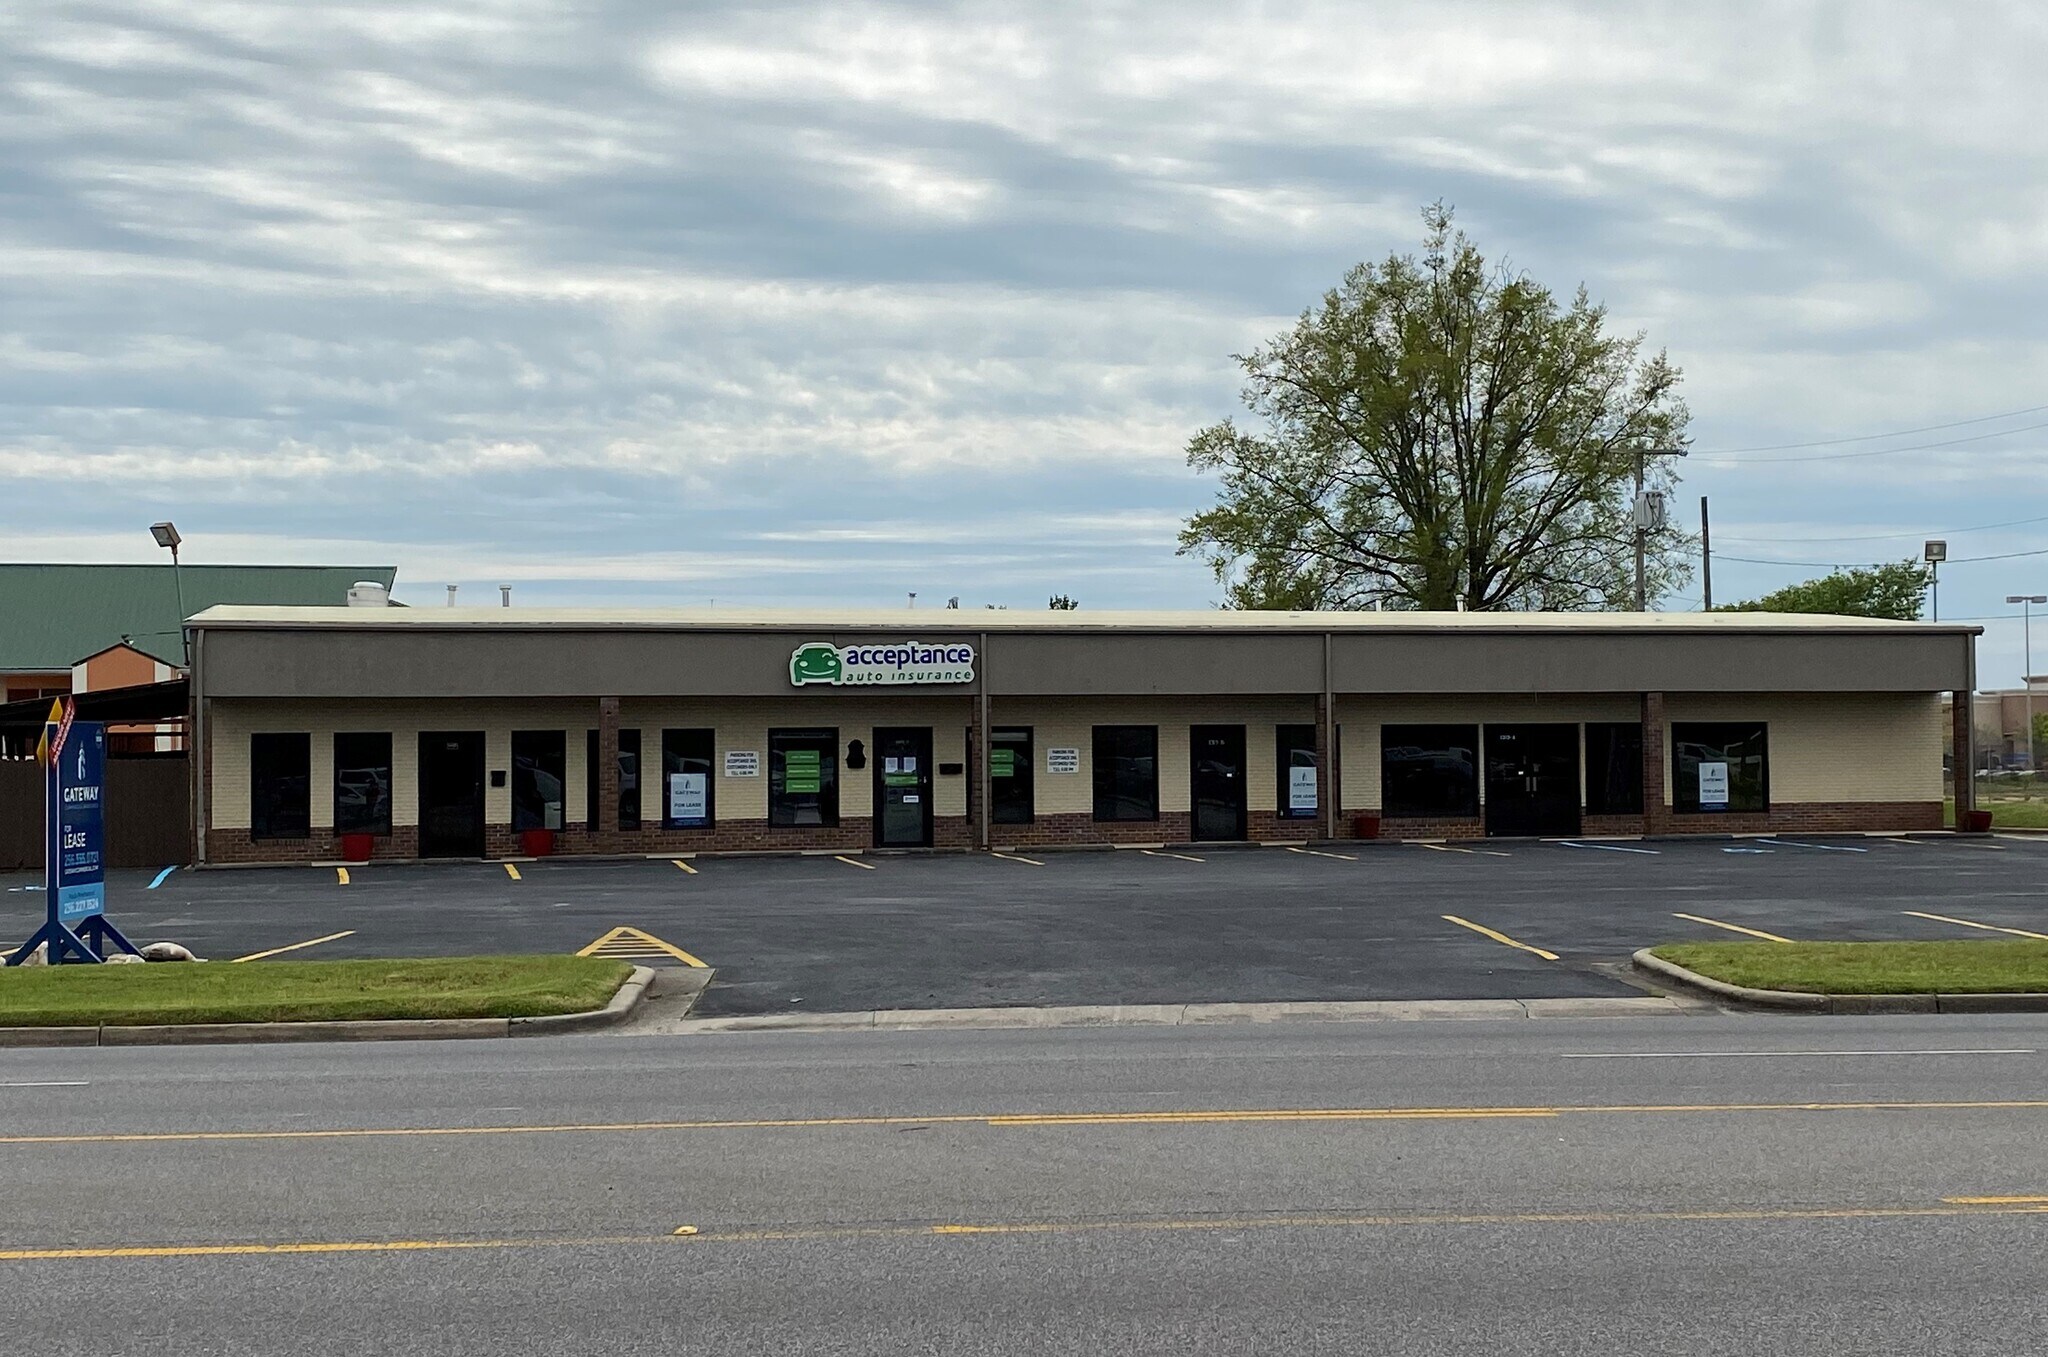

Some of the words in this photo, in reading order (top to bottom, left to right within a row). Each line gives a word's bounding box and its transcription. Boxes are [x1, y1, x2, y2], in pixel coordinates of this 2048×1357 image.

[846, 646, 971, 670] acceptance
[847, 672, 882, 682] auto
[891, 670, 971, 681] insurance
[64, 786, 99, 802] GATEWAY
[64, 832, 86, 849] LEASE
